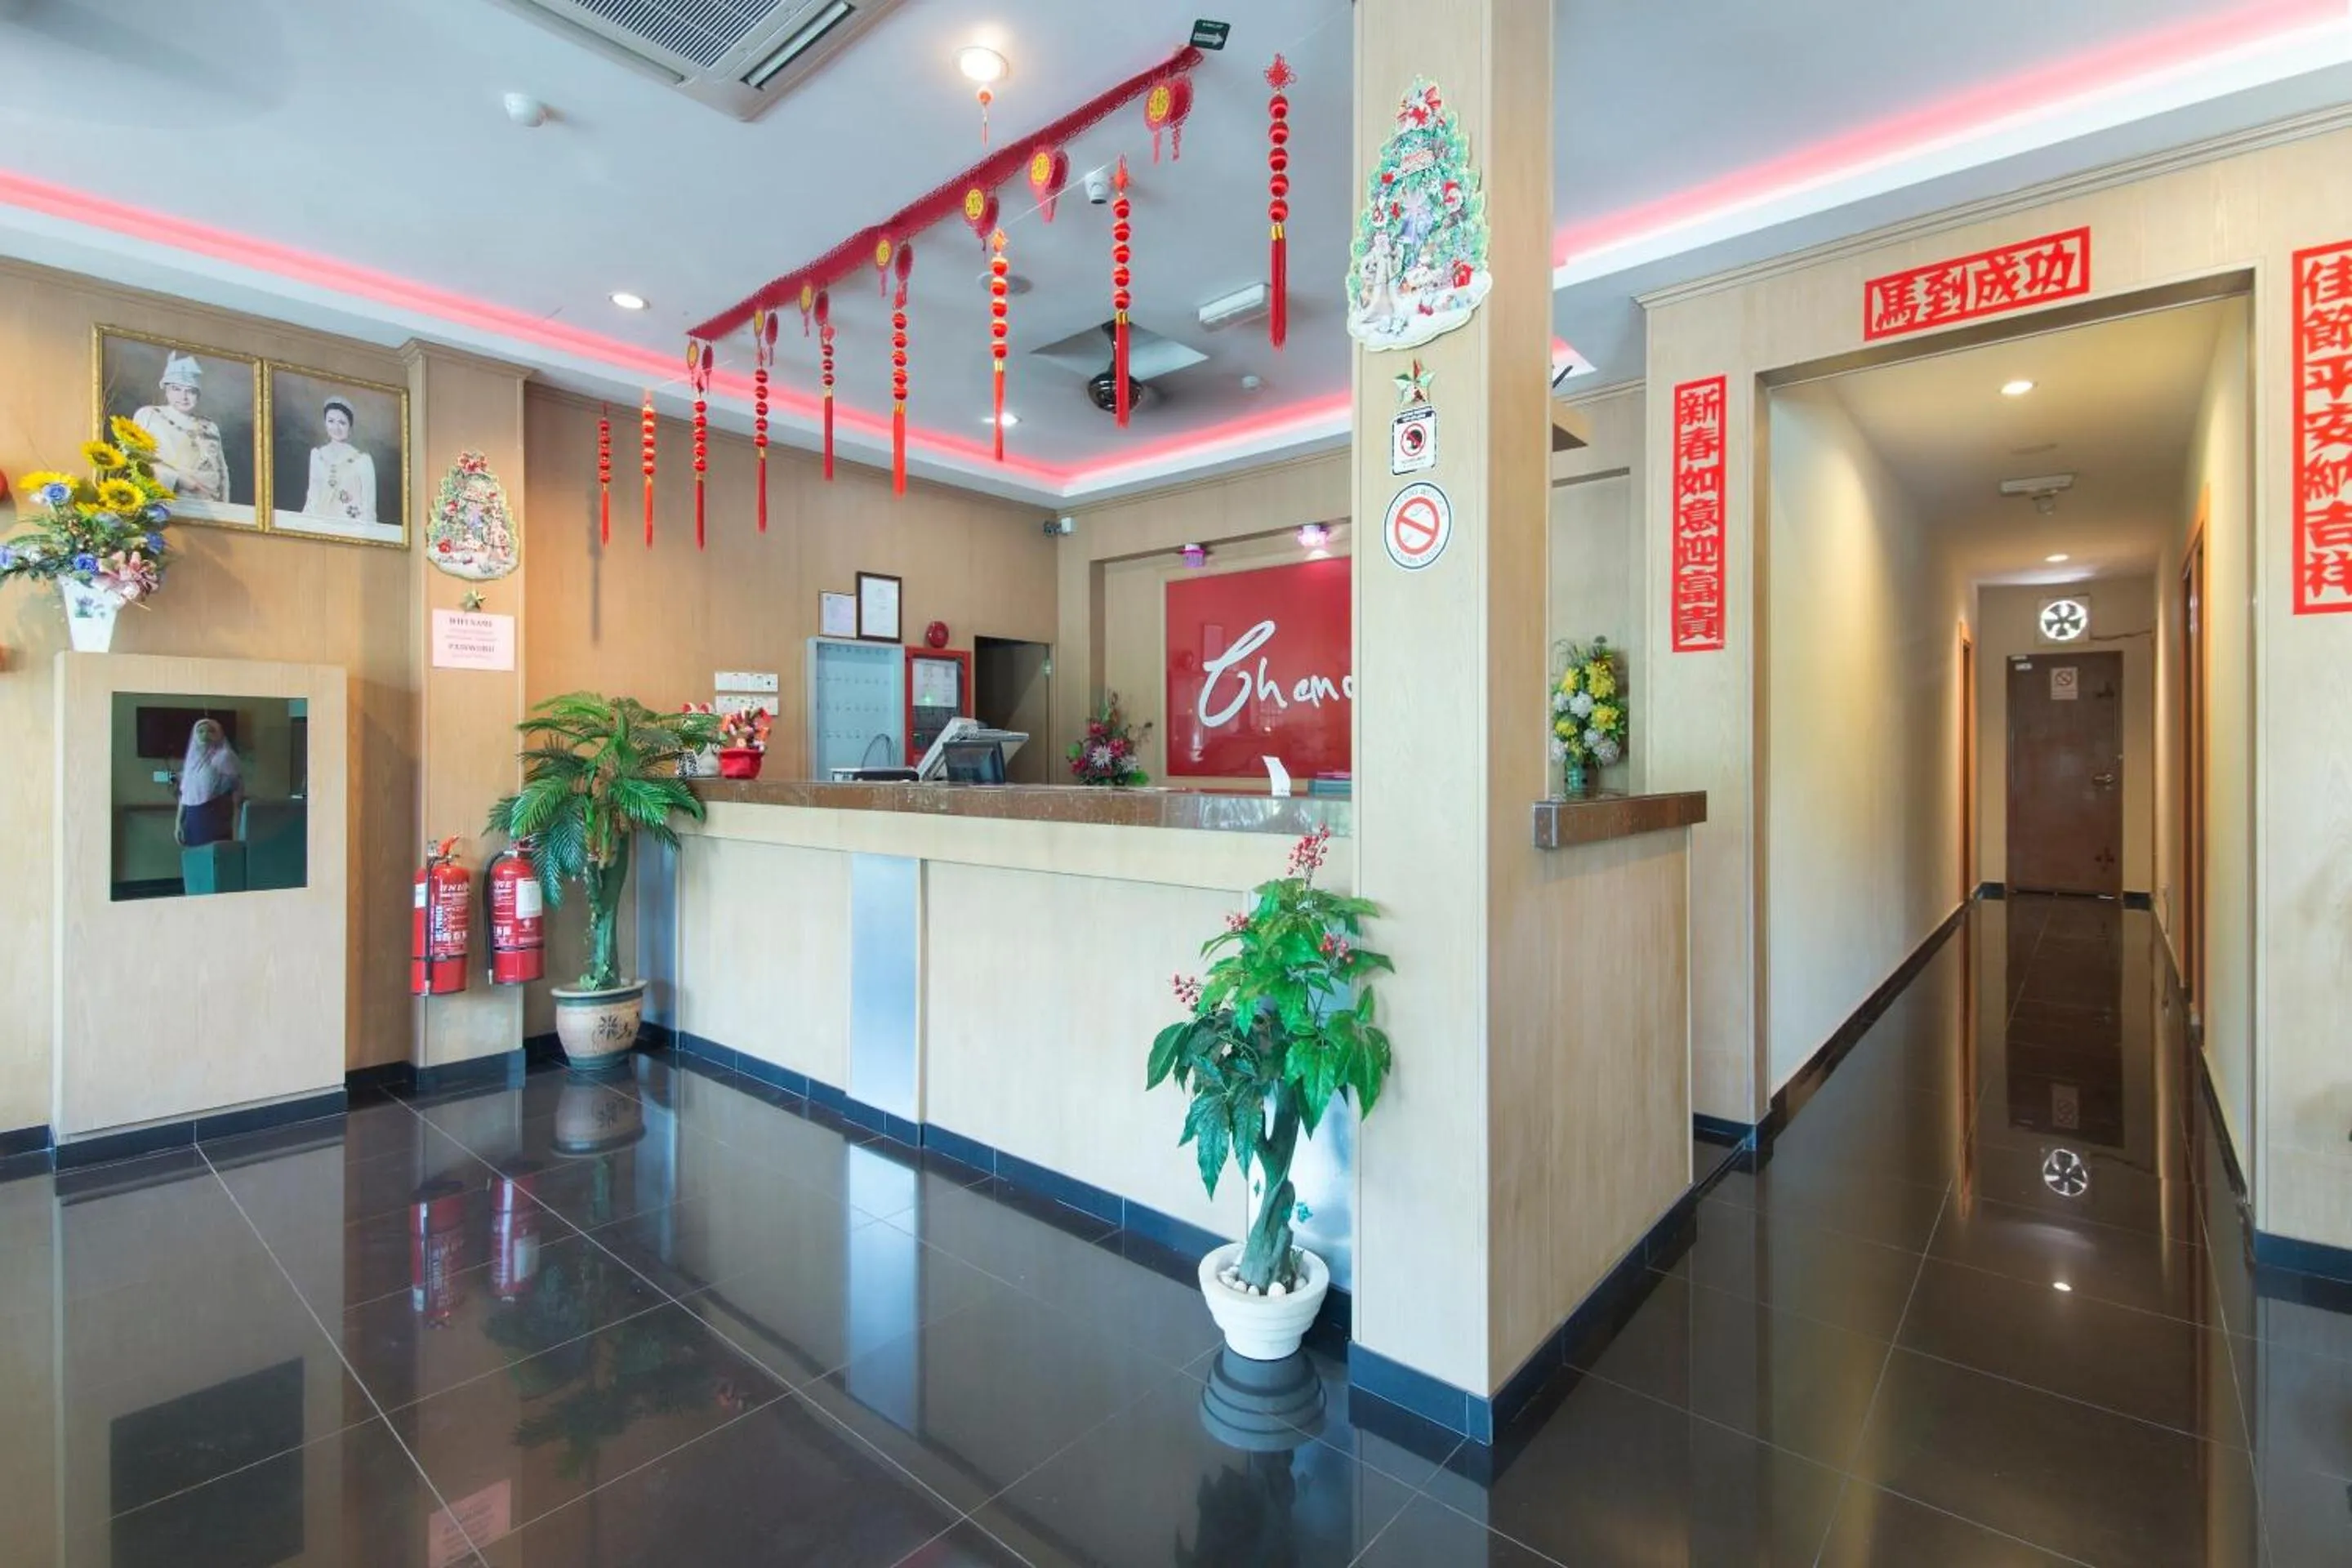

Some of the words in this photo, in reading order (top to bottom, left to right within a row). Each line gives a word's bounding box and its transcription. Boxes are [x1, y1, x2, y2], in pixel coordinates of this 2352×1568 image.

[1873, 243, 2077, 329] 馬到成功
[1680, 387, 1720, 644] 新春如意迎富貴
